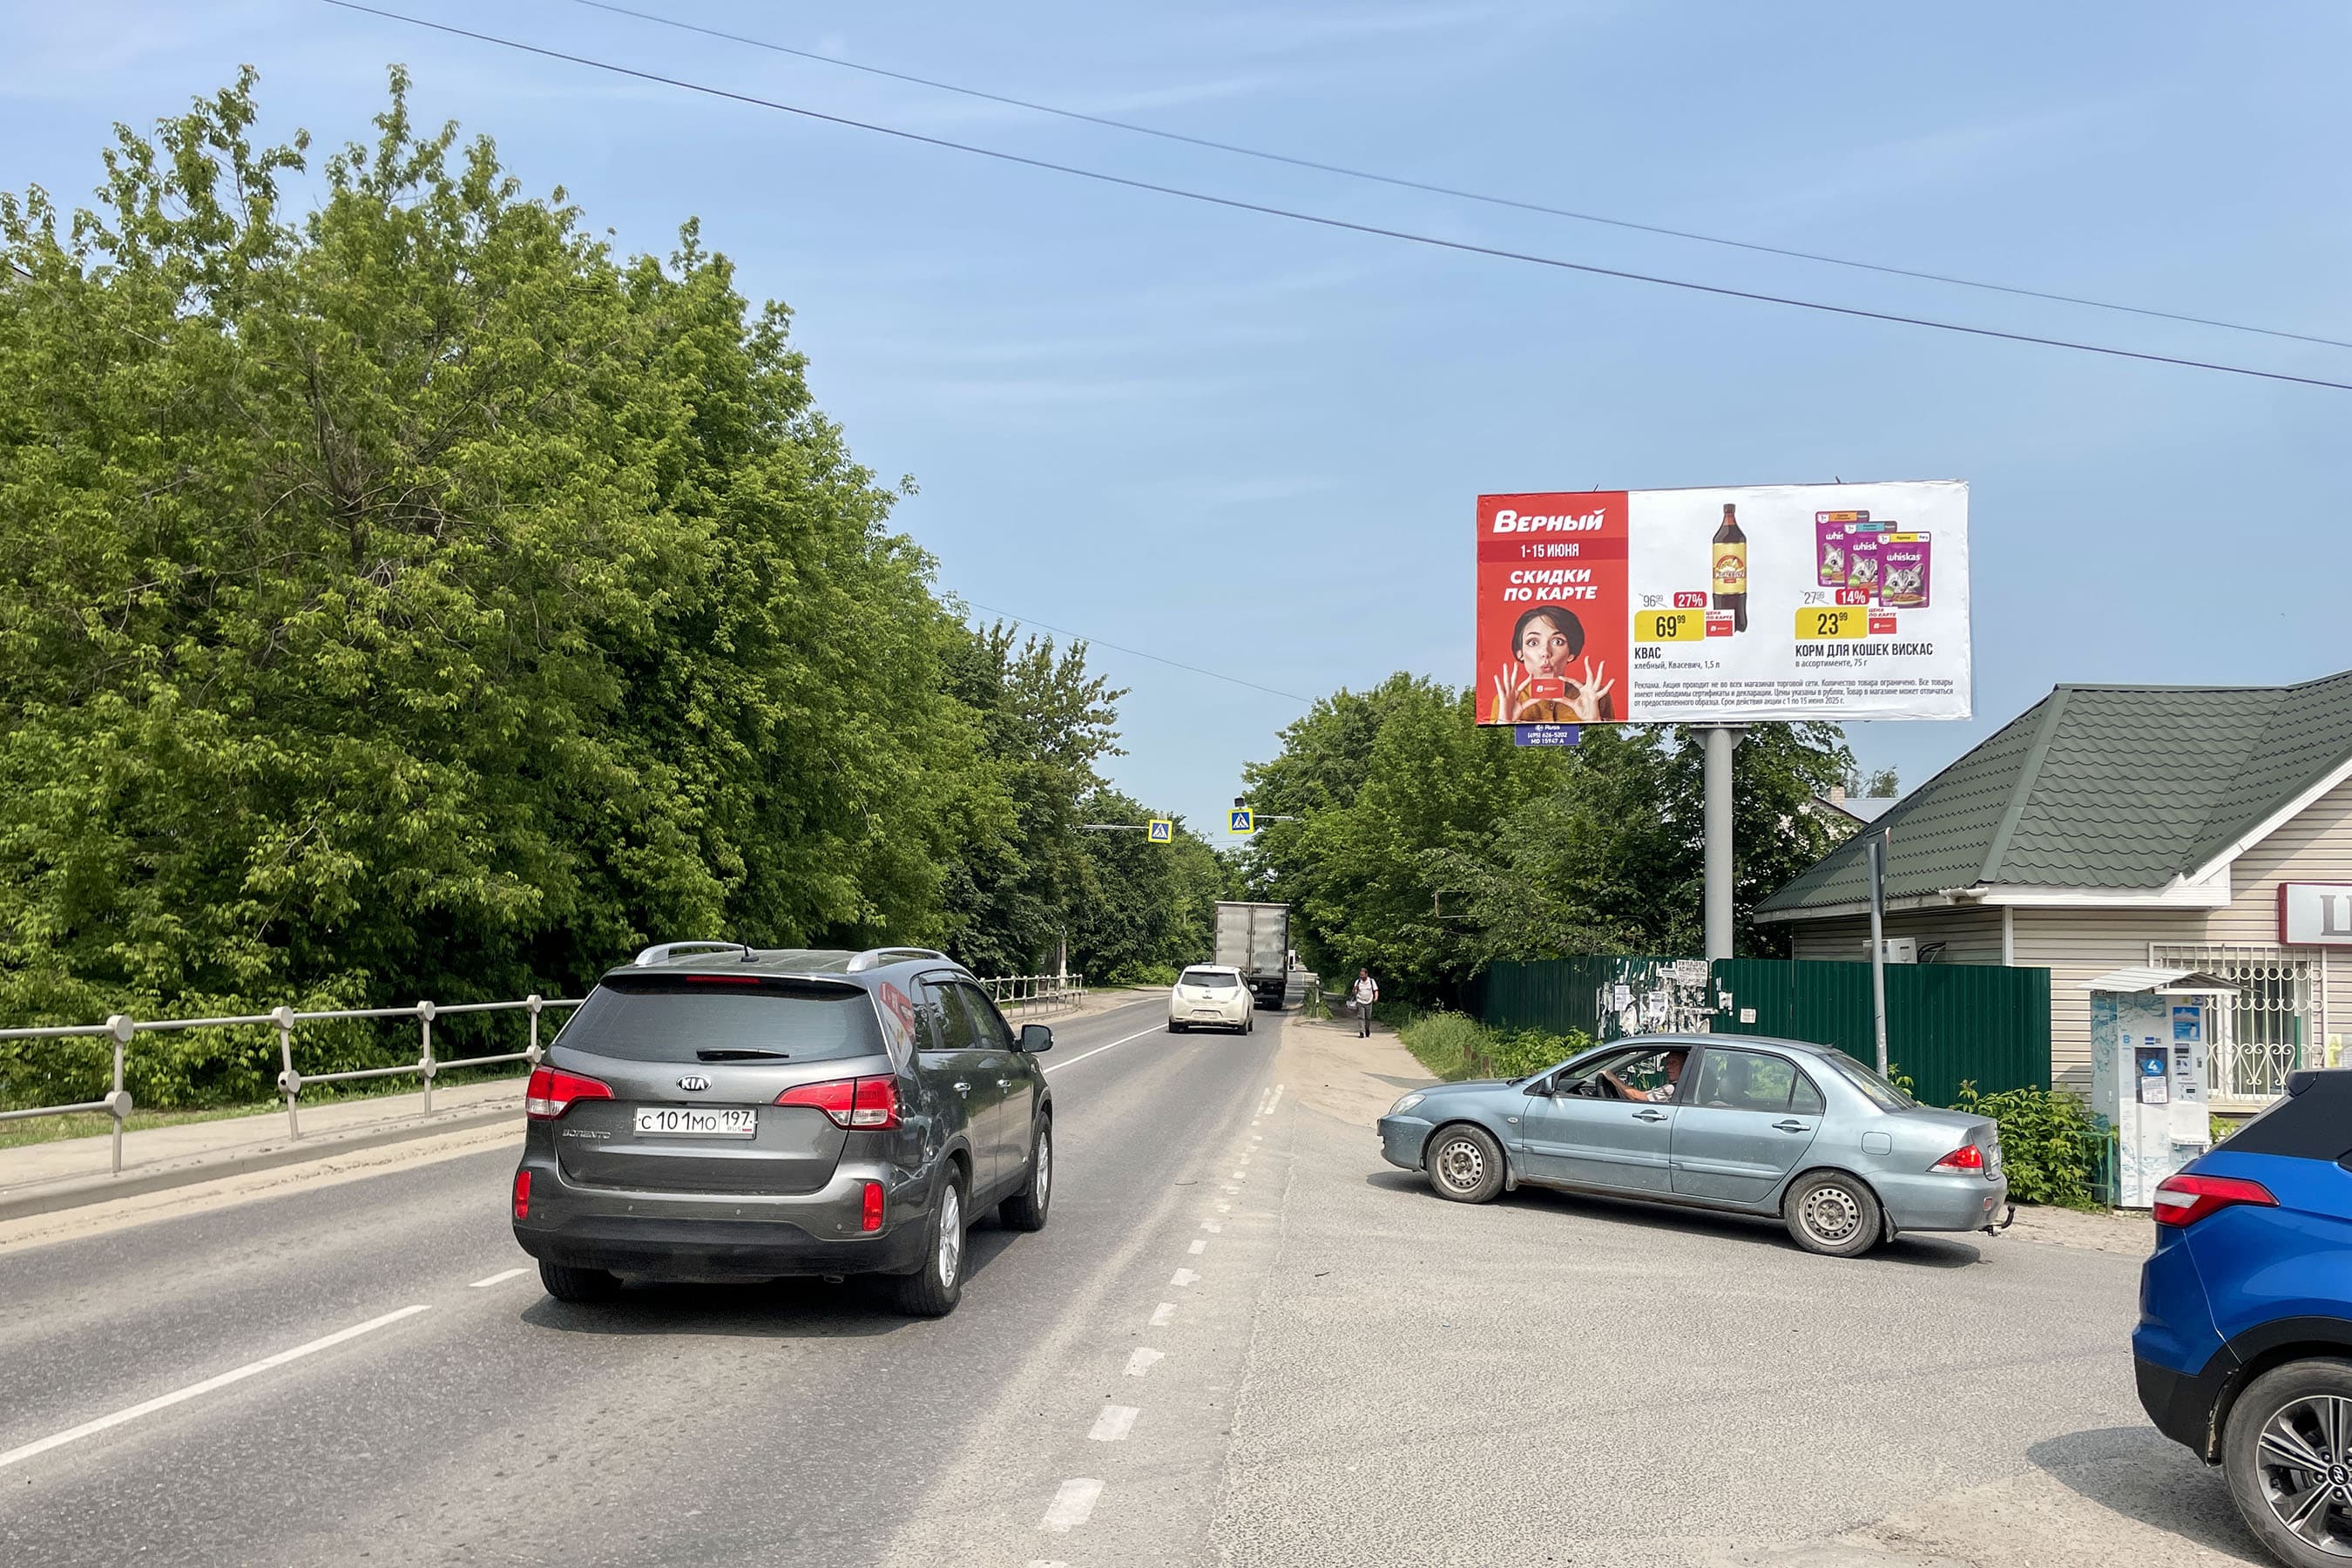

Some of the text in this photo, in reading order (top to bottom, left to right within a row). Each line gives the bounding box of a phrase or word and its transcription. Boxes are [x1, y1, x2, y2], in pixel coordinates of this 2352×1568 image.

[1493, 509, 1605, 533] Верный
[1547, 544, 1579, 558] ИЮНЯ
[1886, 552, 1922, 562] whiskas
[1510, 569, 1592, 585] СКИДКИ
[1504, 585, 1598, 601] ПО КАРТЕ
[1841, 591, 1866, 604] 14%
[1678, 594, 1703, 607] 27%
[1634, 647, 1661, 659] КВАС
[1795, 643, 1933, 658] КОРМ ДЛЯ КОШЕК ВИСКАС
[1801, 659, 1853, 669] ассортименте,
[681, 1078, 705, 1089] KIA
[722, 1111, 750, 1126] 197
